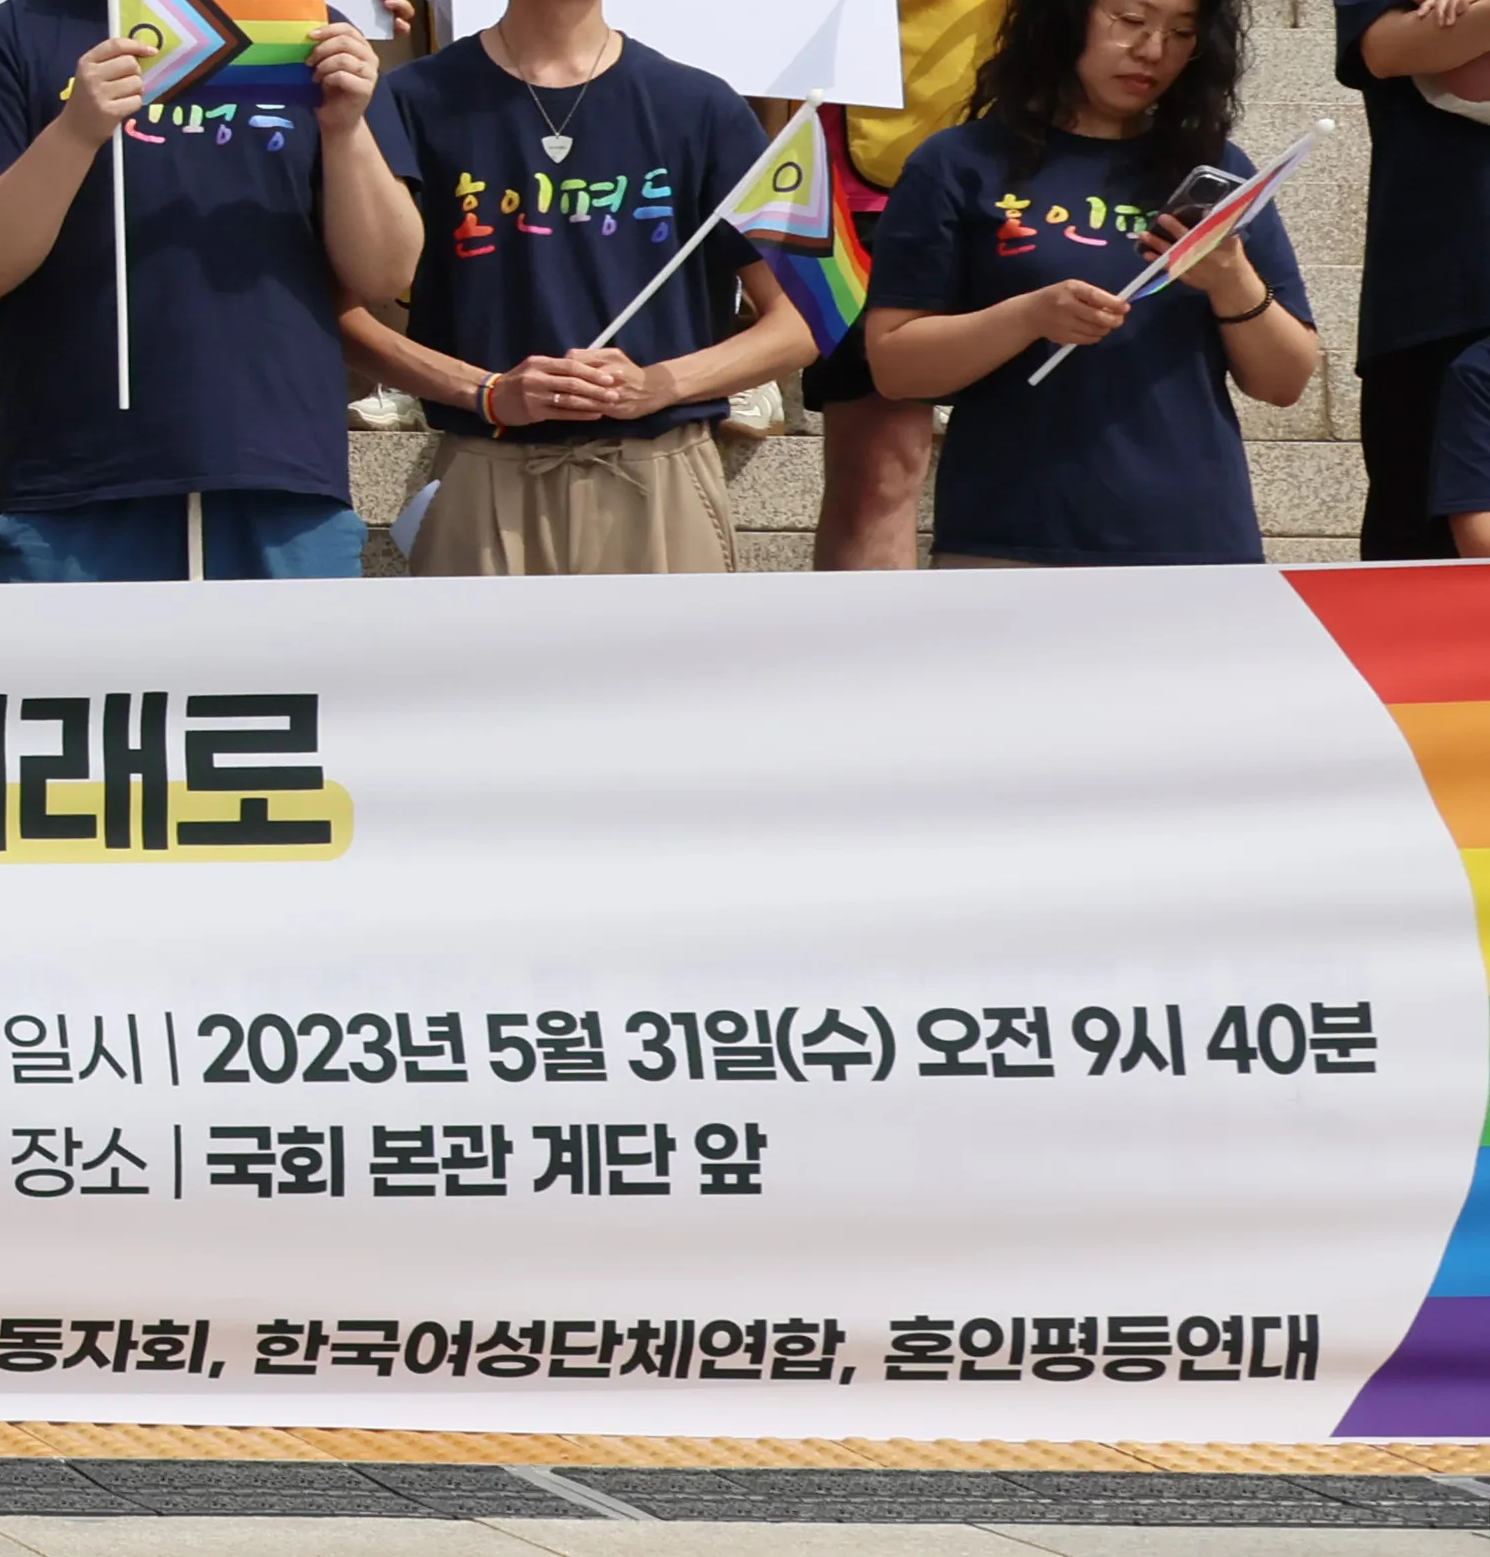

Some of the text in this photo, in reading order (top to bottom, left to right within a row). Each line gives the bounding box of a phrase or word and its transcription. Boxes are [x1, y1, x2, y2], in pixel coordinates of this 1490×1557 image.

[453, 168, 675, 257] 혼인평등
[5, 1002, 1376, 1083] 일시 2023년 5월 31일(수) 오전 9시 40분
[12, 1123, 766, 1197] 장소 국회 본관 계단 앞
[255, 1318, 855, 1384] 한국여성단체연합,
[885, 1315, 1318, 1381] 혼인평등연대
